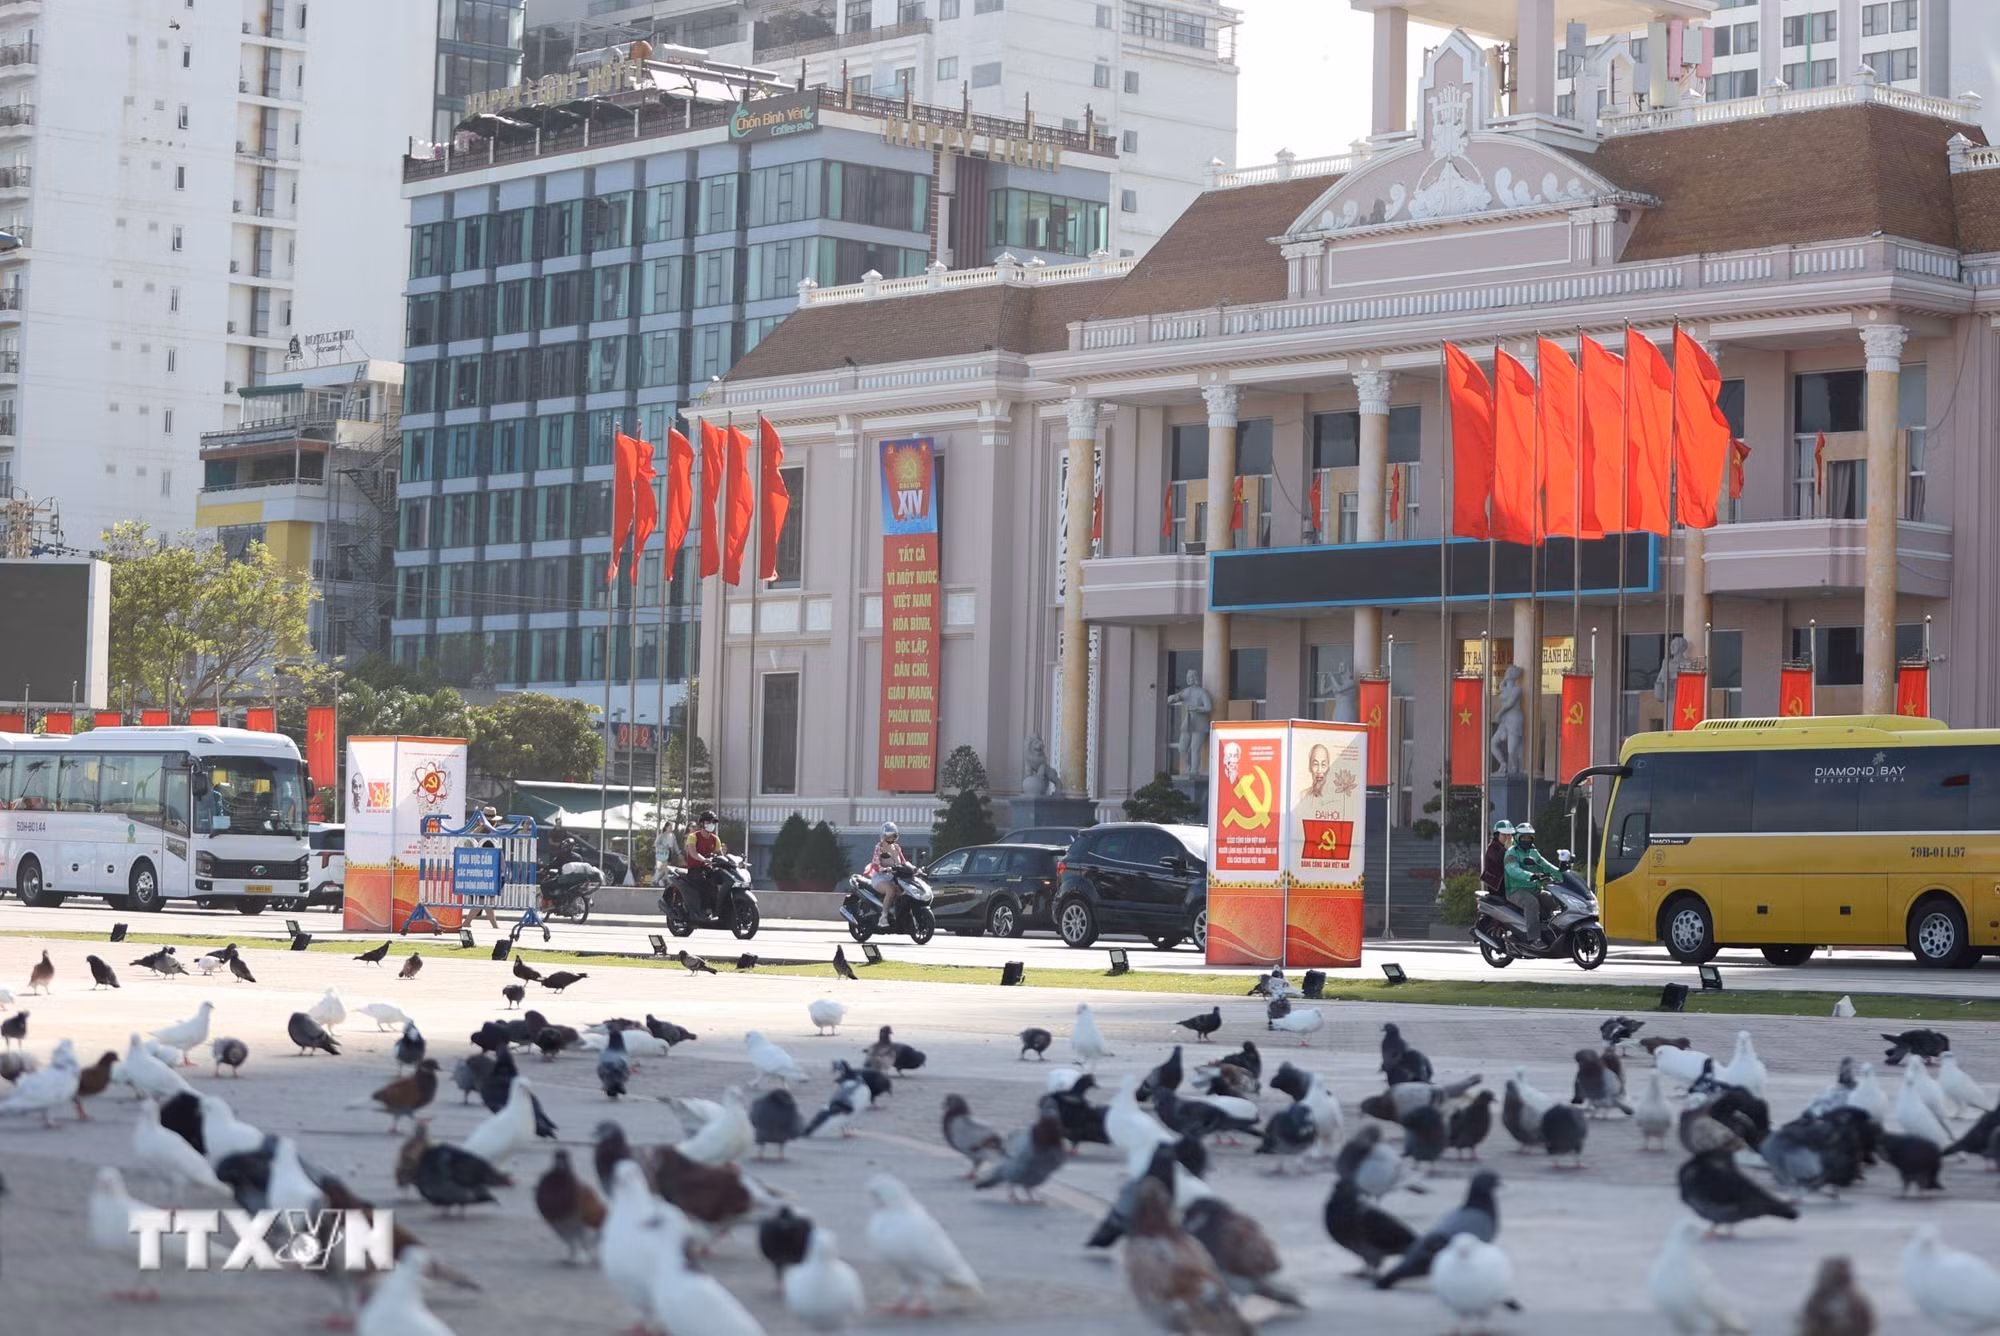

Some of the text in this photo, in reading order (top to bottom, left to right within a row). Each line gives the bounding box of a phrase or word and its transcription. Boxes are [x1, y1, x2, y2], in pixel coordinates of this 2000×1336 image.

[464, 85, 522, 117] HAPPY
[588, 58, 645, 95] HOTEL
[763, 110, 785, 126] Bình
[771, 123, 797, 136] Coffee
[886, 115, 1064, 172] HAPPY LIGHT
[897, 489, 923, 515] XIV
[899, 543, 926, 562] TẤT CẢ
[887, 567, 938, 587] VÌ MỘT NƯỚC
[893, 591, 932, 611] VIỆT NAM
[910, 614, 932, 632] BÌNH,
[895, 638, 929, 656] ĐỘC LẬP,
[894, 659, 930, 679] DÂN CHỦ,
[888, 684, 934, 702] GIÀU MẠNH,
[888, 704, 932, 726] PHỒN VINH,
[889, 730, 929, 746] VĂN MINH
[884, 752, 931, 772] HẠNH PHÚC!
[1814, 766, 1906, 777] DIAMOND BAY
[459, 854, 470, 864] KHU
[1911, 846, 1966, 858] 79B-011.97
